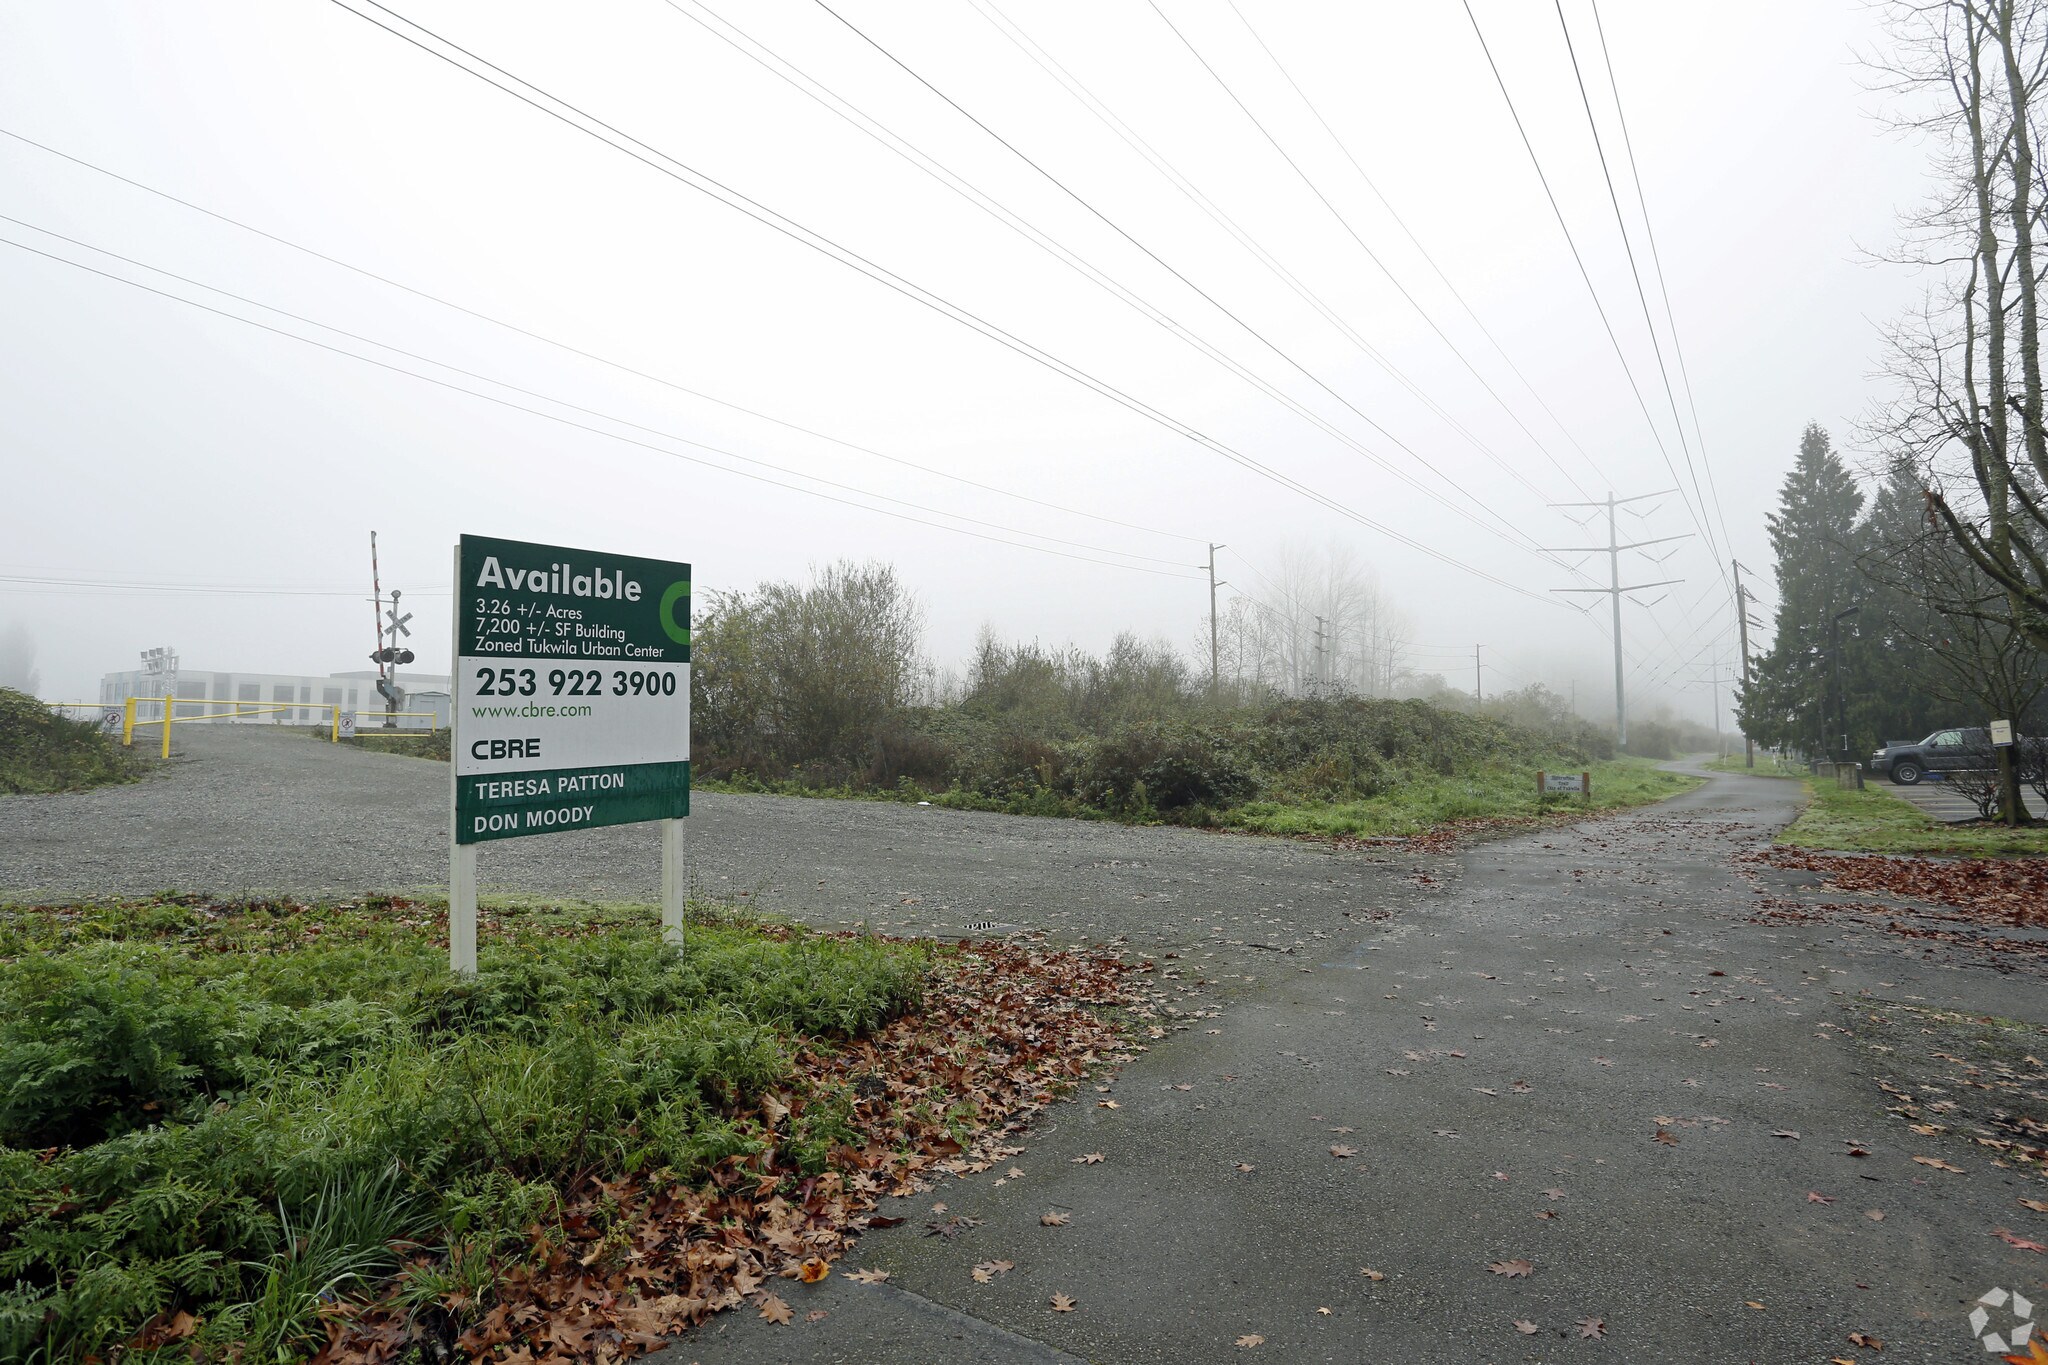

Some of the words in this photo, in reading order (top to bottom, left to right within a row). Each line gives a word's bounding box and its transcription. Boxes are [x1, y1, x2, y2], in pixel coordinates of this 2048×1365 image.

[476, 556, 642, 602] Available
[476, 598, 511, 615] 3.26
[516, 602, 542, 618] +/-
[546, 604, 583, 620] Acres
[476, 617, 520, 636] 7,200
[526, 621, 550, 637] +/-
[555, 622, 571, 637] SF
[575, 624, 626, 643] Building
[475, 636, 522, 653] Zoned
[527, 638, 577, 655] Tukwila
[582, 642, 621, 656] Urban
[625, 643, 664, 658] Center
[476, 667, 537, 696] 253
[548, 669, 602, 696] 922
[612, 671, 676, 696] 3900
[472, 701, 592, 718] www.cbre.com
[471, 738, 541, 760] CBRE
[475, 778, 551, 800] TERESA
[558, 772, 625, 793] PATTON
[474, 813, 519, 833] DON
[526, 805, 594, 828] MOODY
